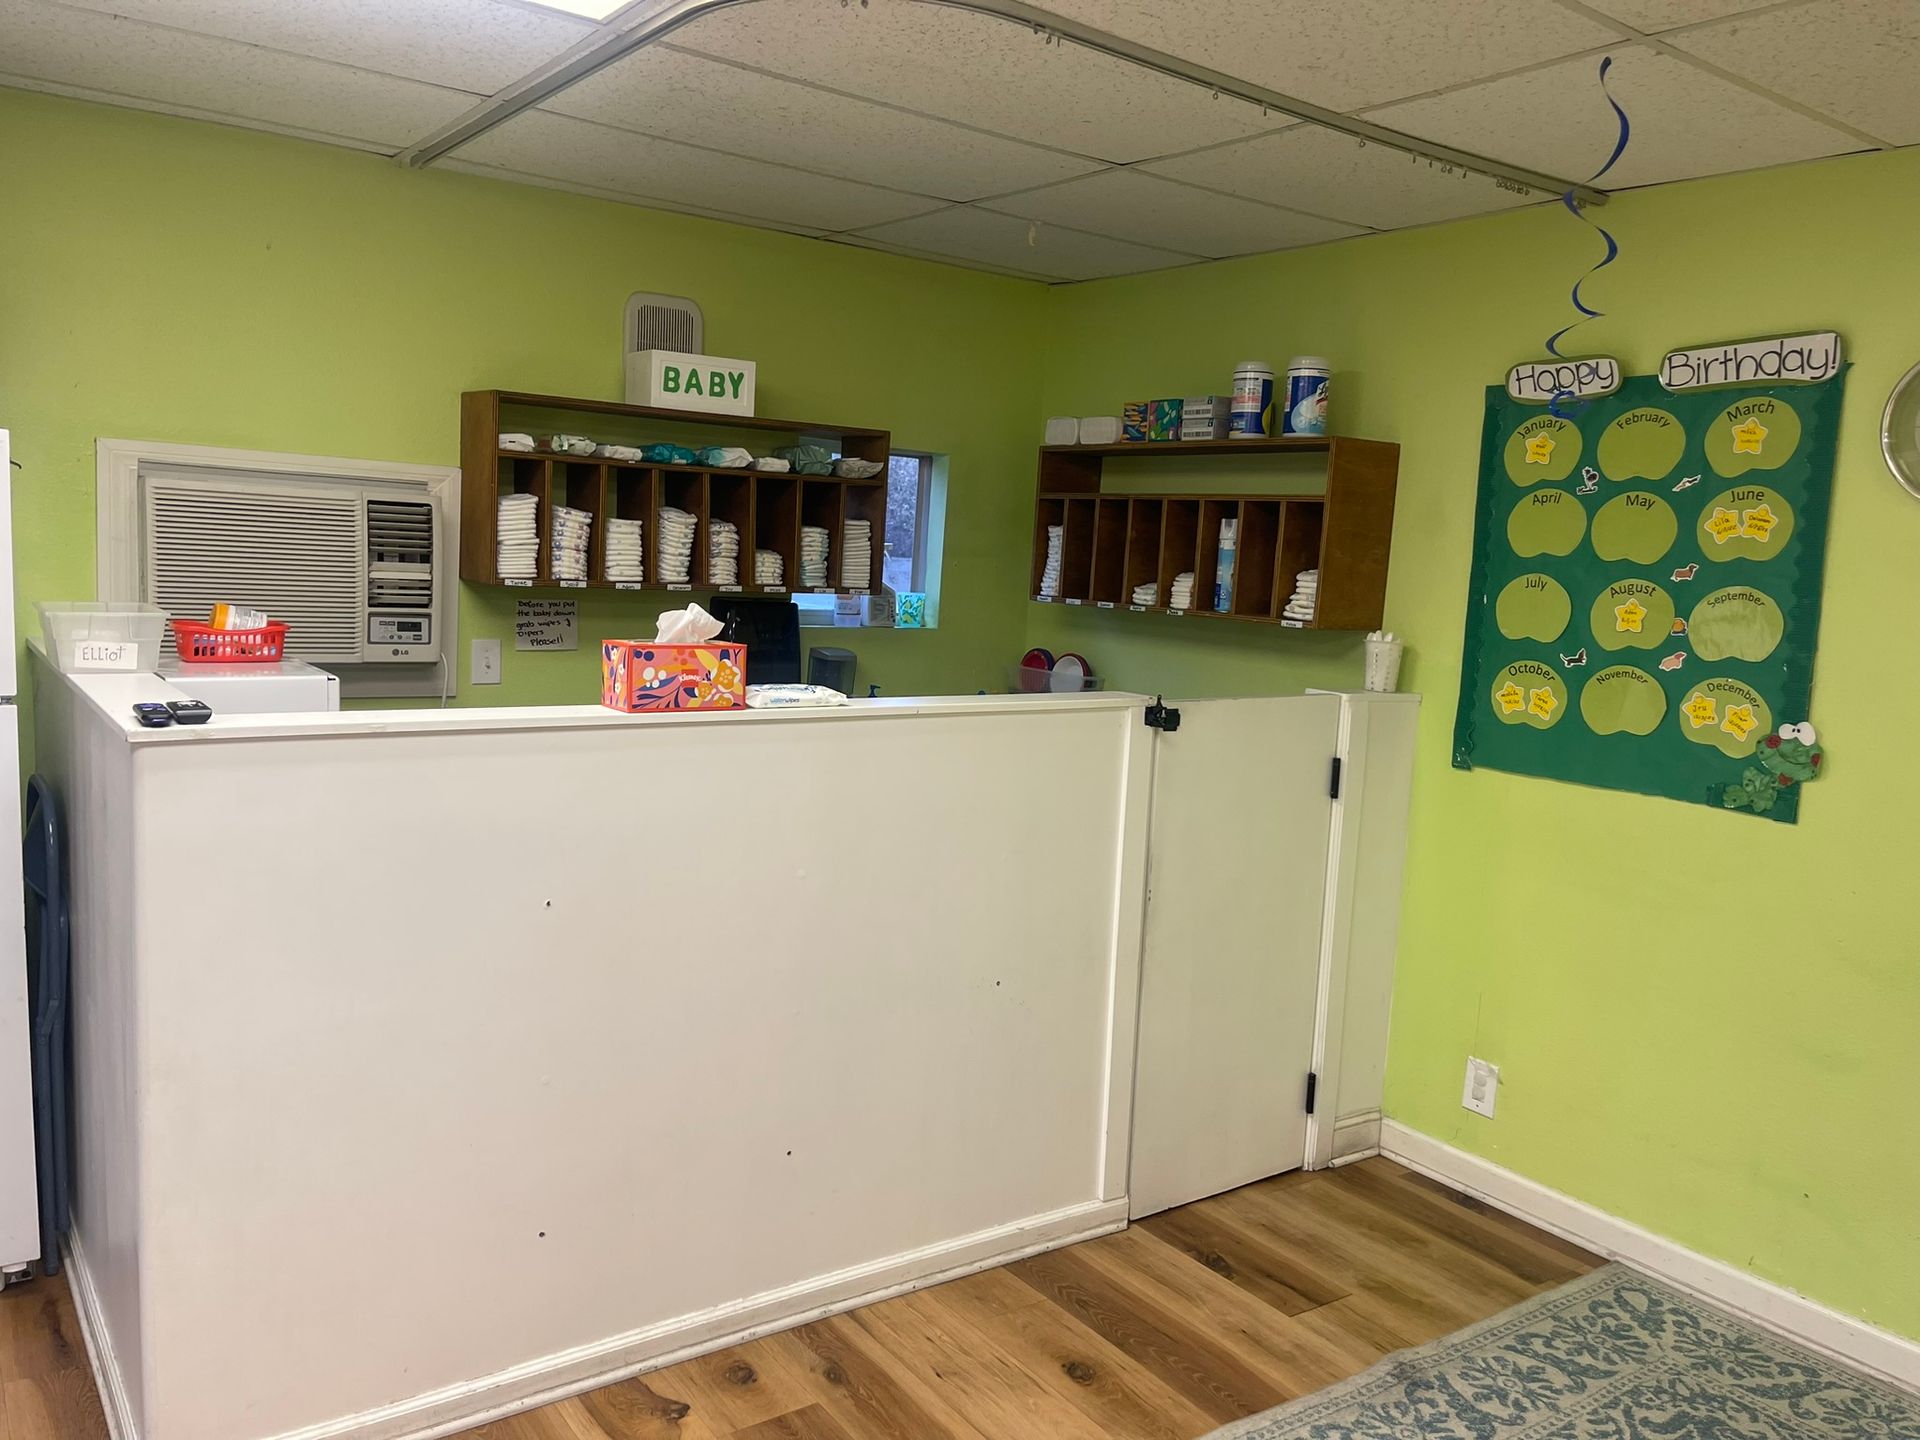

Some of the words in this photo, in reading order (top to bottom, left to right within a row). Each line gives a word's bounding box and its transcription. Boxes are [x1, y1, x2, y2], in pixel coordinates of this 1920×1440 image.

[1515, 360, 1615, 395] Happy
[1666, 335, 1838, 388] Birthday!
[662, 366, 744, 399] BABY
[1726, 400, 1775, 422] March
[1517, 419, 1567, 439] January
[1616, 412, 1671, 430] February
[1532, 492, 1562, 505] April
[1626, 494, 1656, 510] May
[1730, 490, 1765, 503] June
[1525, 577, 1548, 591] July
[1610, 583, 1657, 599] August
[548, 601, 561, 609] you
[1706, 591, 1766, 608] September
[1508, 664, 1556, 681] October
[1596, 670, 1649, 685] November
[1706, 682, 1760, 709] December
